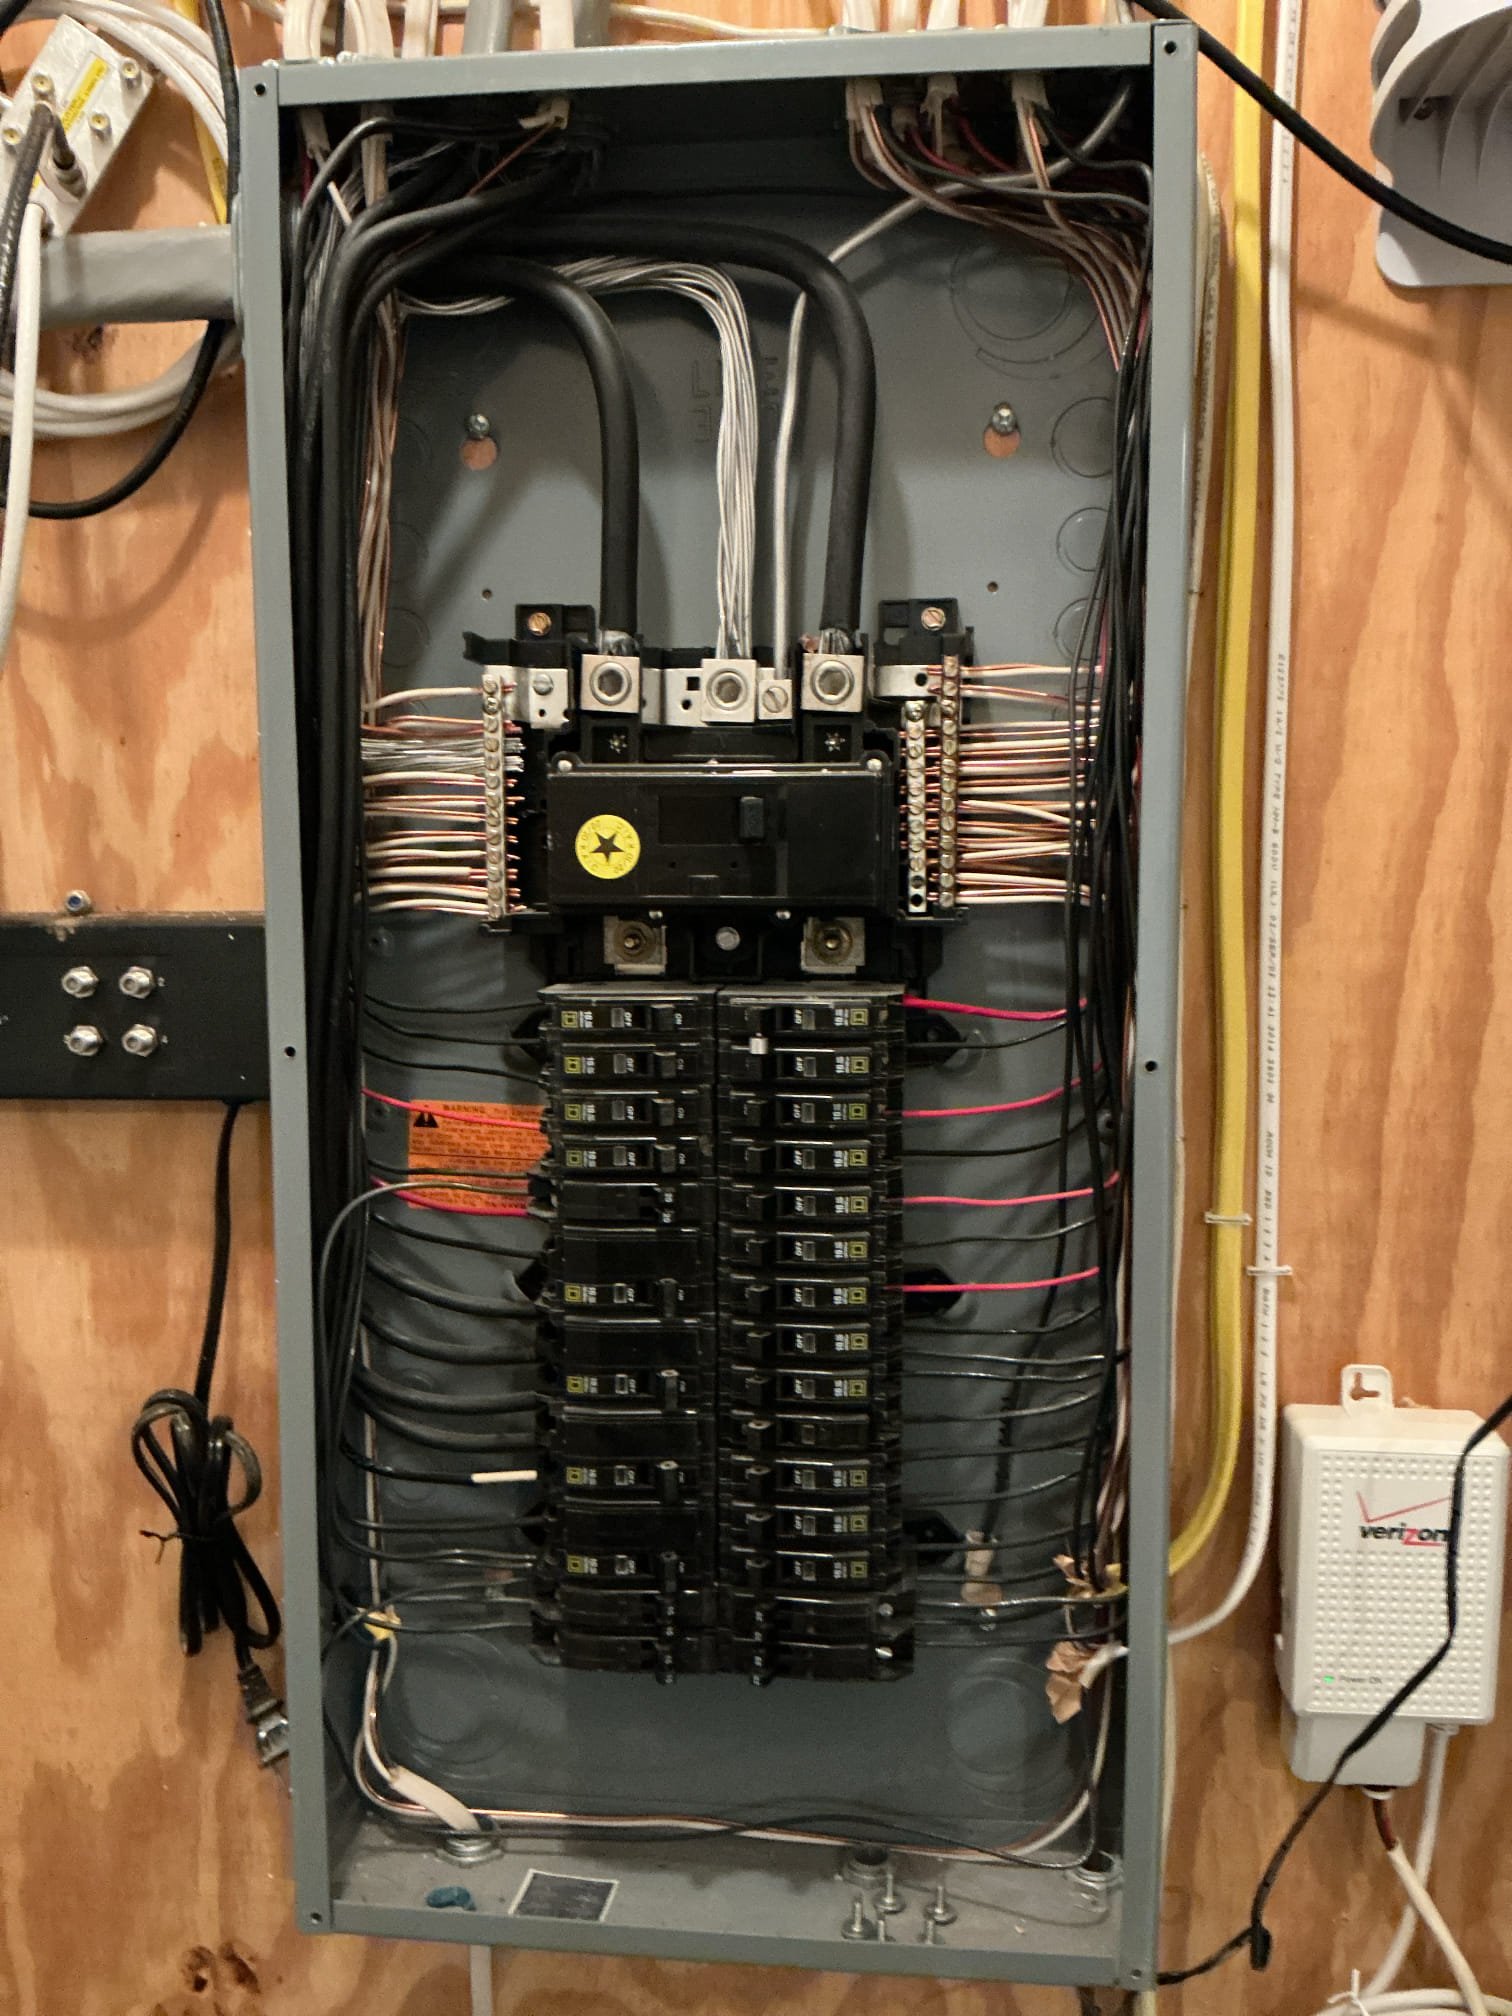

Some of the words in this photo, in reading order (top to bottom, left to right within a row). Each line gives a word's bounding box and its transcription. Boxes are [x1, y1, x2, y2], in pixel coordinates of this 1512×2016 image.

[624, 1012, 632, 1027] OFF
[794, 1009, 802, 1024] OFF
[795, 1057, 803, 1071] OFF
[794, 1150, 802, 1165] OFF
[795, 1197, 803, 1211] OFF
[794, 1242, 802, 1256] OFF
[794, 1288, 802, 1302] OFF
[1359, 1522, 1452, 1547] verizon
